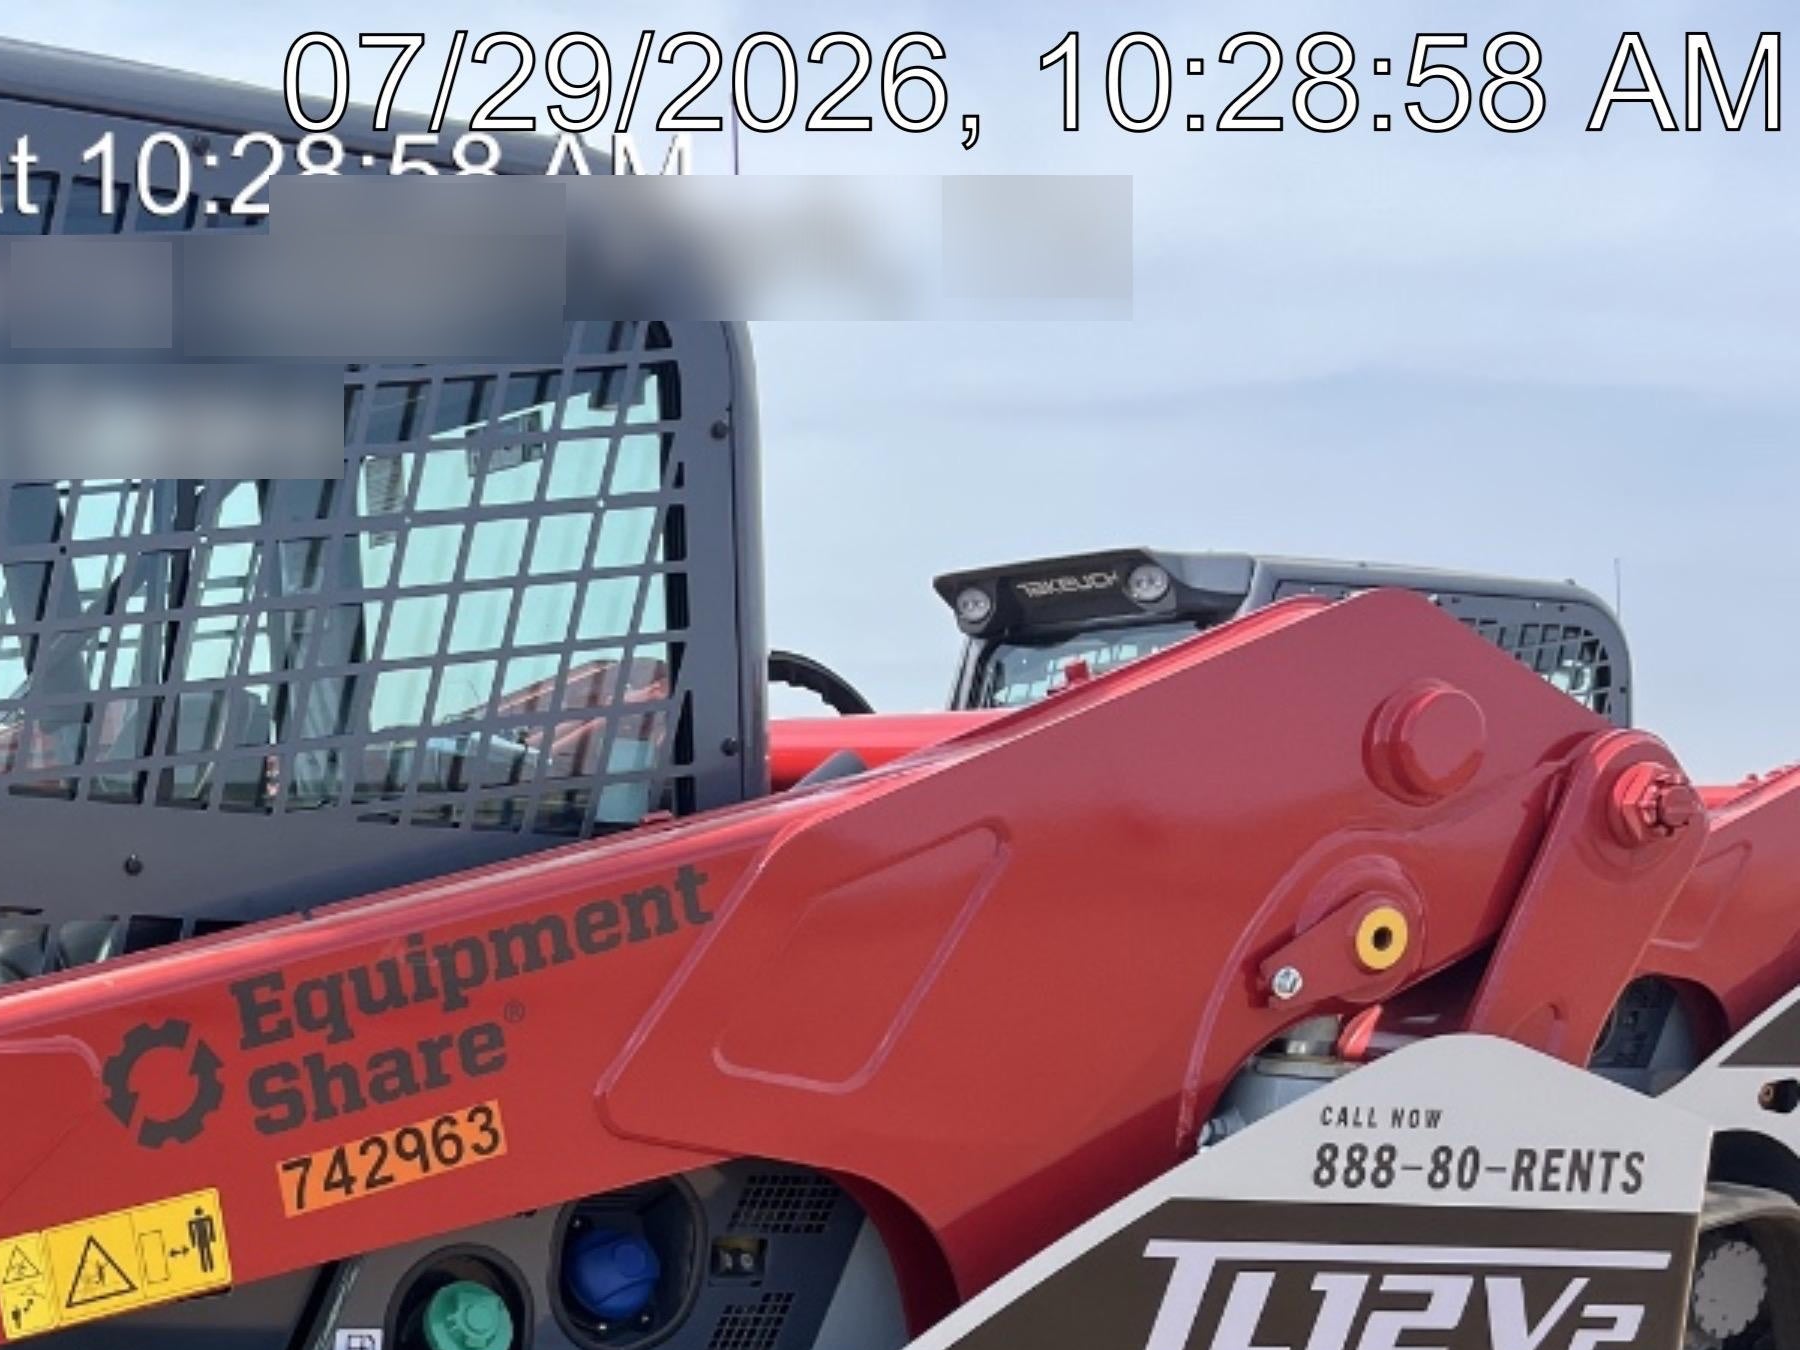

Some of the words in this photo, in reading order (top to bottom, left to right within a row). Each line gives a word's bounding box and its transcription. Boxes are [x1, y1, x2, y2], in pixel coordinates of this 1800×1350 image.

[228, 863, 715, 1050] Equipment
[1320, 1106, 1378, 1128] CALL
[1391, 1109, 1443, 1128] NOW
[281, 1104, 501, 1210] 742963
[1313, 1142, 1645, 1195] 888-80-RENTS
